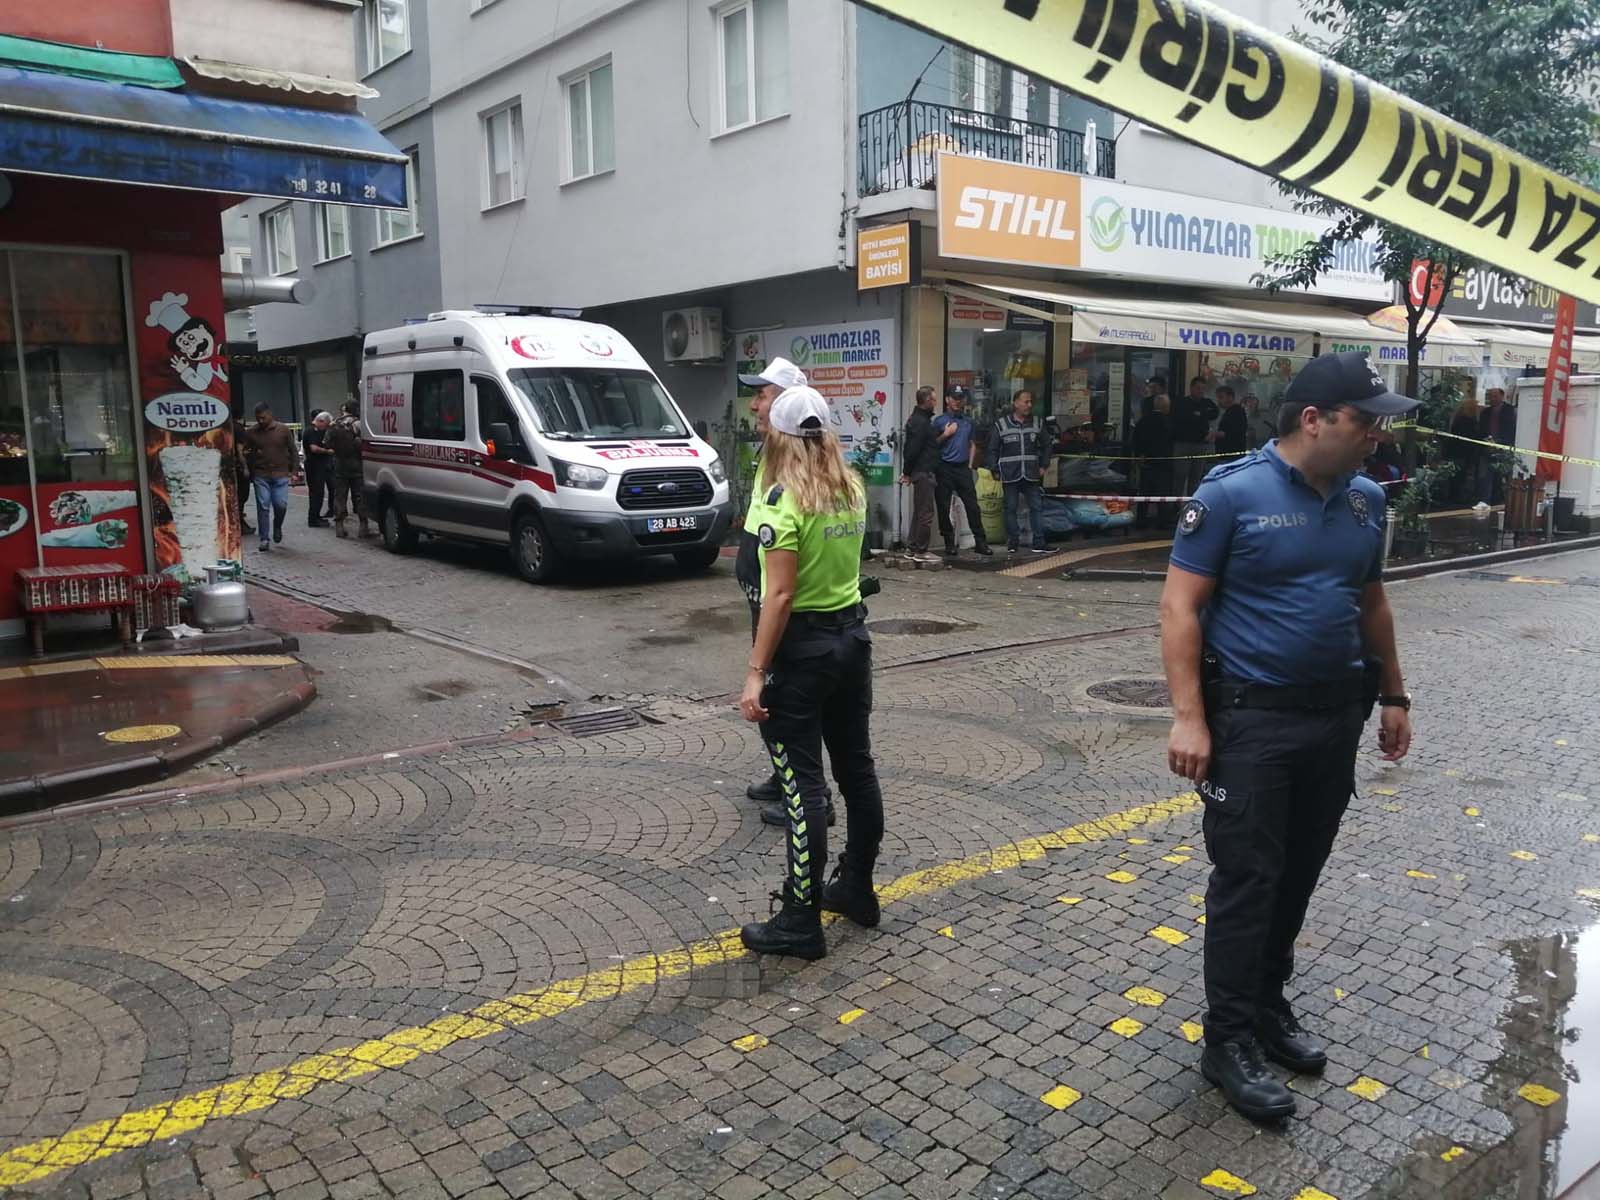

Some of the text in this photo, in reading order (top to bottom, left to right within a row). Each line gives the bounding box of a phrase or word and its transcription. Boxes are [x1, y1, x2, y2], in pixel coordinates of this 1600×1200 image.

[1003, 0, 1600, 281] ZA YERİ GİRİ
[954, 185, 1076, 241] STIHL
[1130, 207, 1252, 259] YILMAZLAR
[811, 329, 881, 350] YILMAZLAR
[1178, 328, 1296, 352] YILMAZLAR
[842, 348, 882, 363] MARKET
[1379, 346, 1427, 361] MART
[156, 401, 217, 416] Namlı
[166, 417, 216, 428] Döner
[381, 411, 398, 433] 112
[414, 443, 457, 461] AMBULANS
[666, 518, 678, 529] AB
[679, 516, 695, 528] 423
[1201, 780, 1227, 801] OLİS
